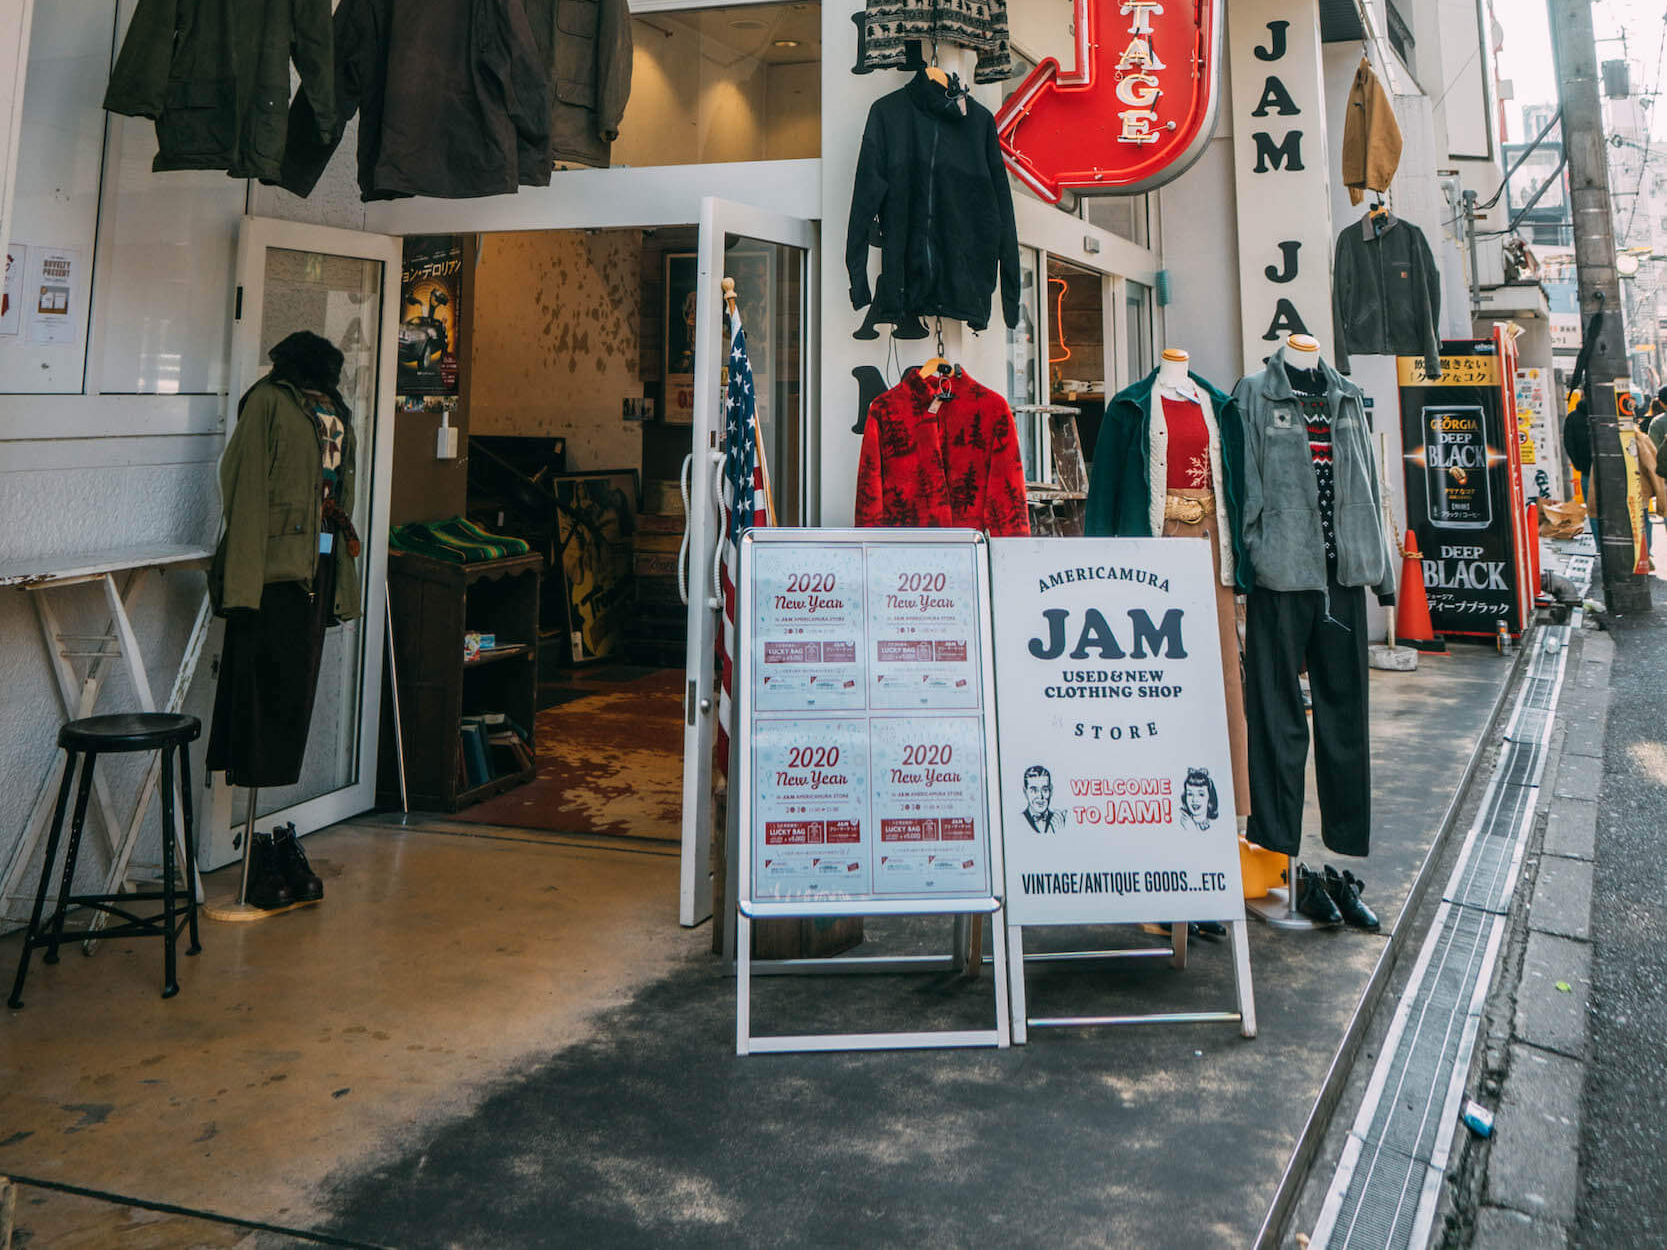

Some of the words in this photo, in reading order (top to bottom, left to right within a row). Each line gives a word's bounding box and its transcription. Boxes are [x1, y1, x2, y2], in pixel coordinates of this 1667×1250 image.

[1251, 19, 1305, 174] JAM
[402, 259, 462, 283] ョン・デロリアン
[1261, 240, 1315, 364] JA
[1414, 358, 1488, 370] 飲飽きない
[1409, 372, 1494, 383] 「クアなコク」
[1440, 433, 1472, 444] DEEP
[1428, 444, 1485, 468] BLACK
[1440, 545, 1484, 559] DEEP
[786, 572, 836, 593] 2020
[897, 572, 946, 592] 2020
[1039, 566, 1170, 593] AMERICAMURA
[1421, 560, 1509, 590] BLACK
[775, 595, 806, 610] New
[808, 595, 844, 613] Year
[886, 594, 917, 609] New
[920, 594, 955, 613] Year
[1028, 608, 1188, 660] JAM
[1062, 670, 1164, 684] USED&NEW
[1044, 686, 1133, 699] CLOTHING
[1137, 685, 1182, 699] SHOP
[1074, 722, 1158, 741] STORE
[788, 746, 840, 768] 2020
[902, 744, 953, 766] 2020
[776, 771, 809, 786] New
[811, 770, 848, 790] Year
[890, 768, 923, 784] New
[925, 768, 962, 788] Year
[1069, 778, 1172, 796] WELCOME
[1073, 806, 1102, 824] TO
[1104, 798, 1172, 824] JAM!
[1022, 871, 1141, 896] VINTAGE/ANTIQUE
